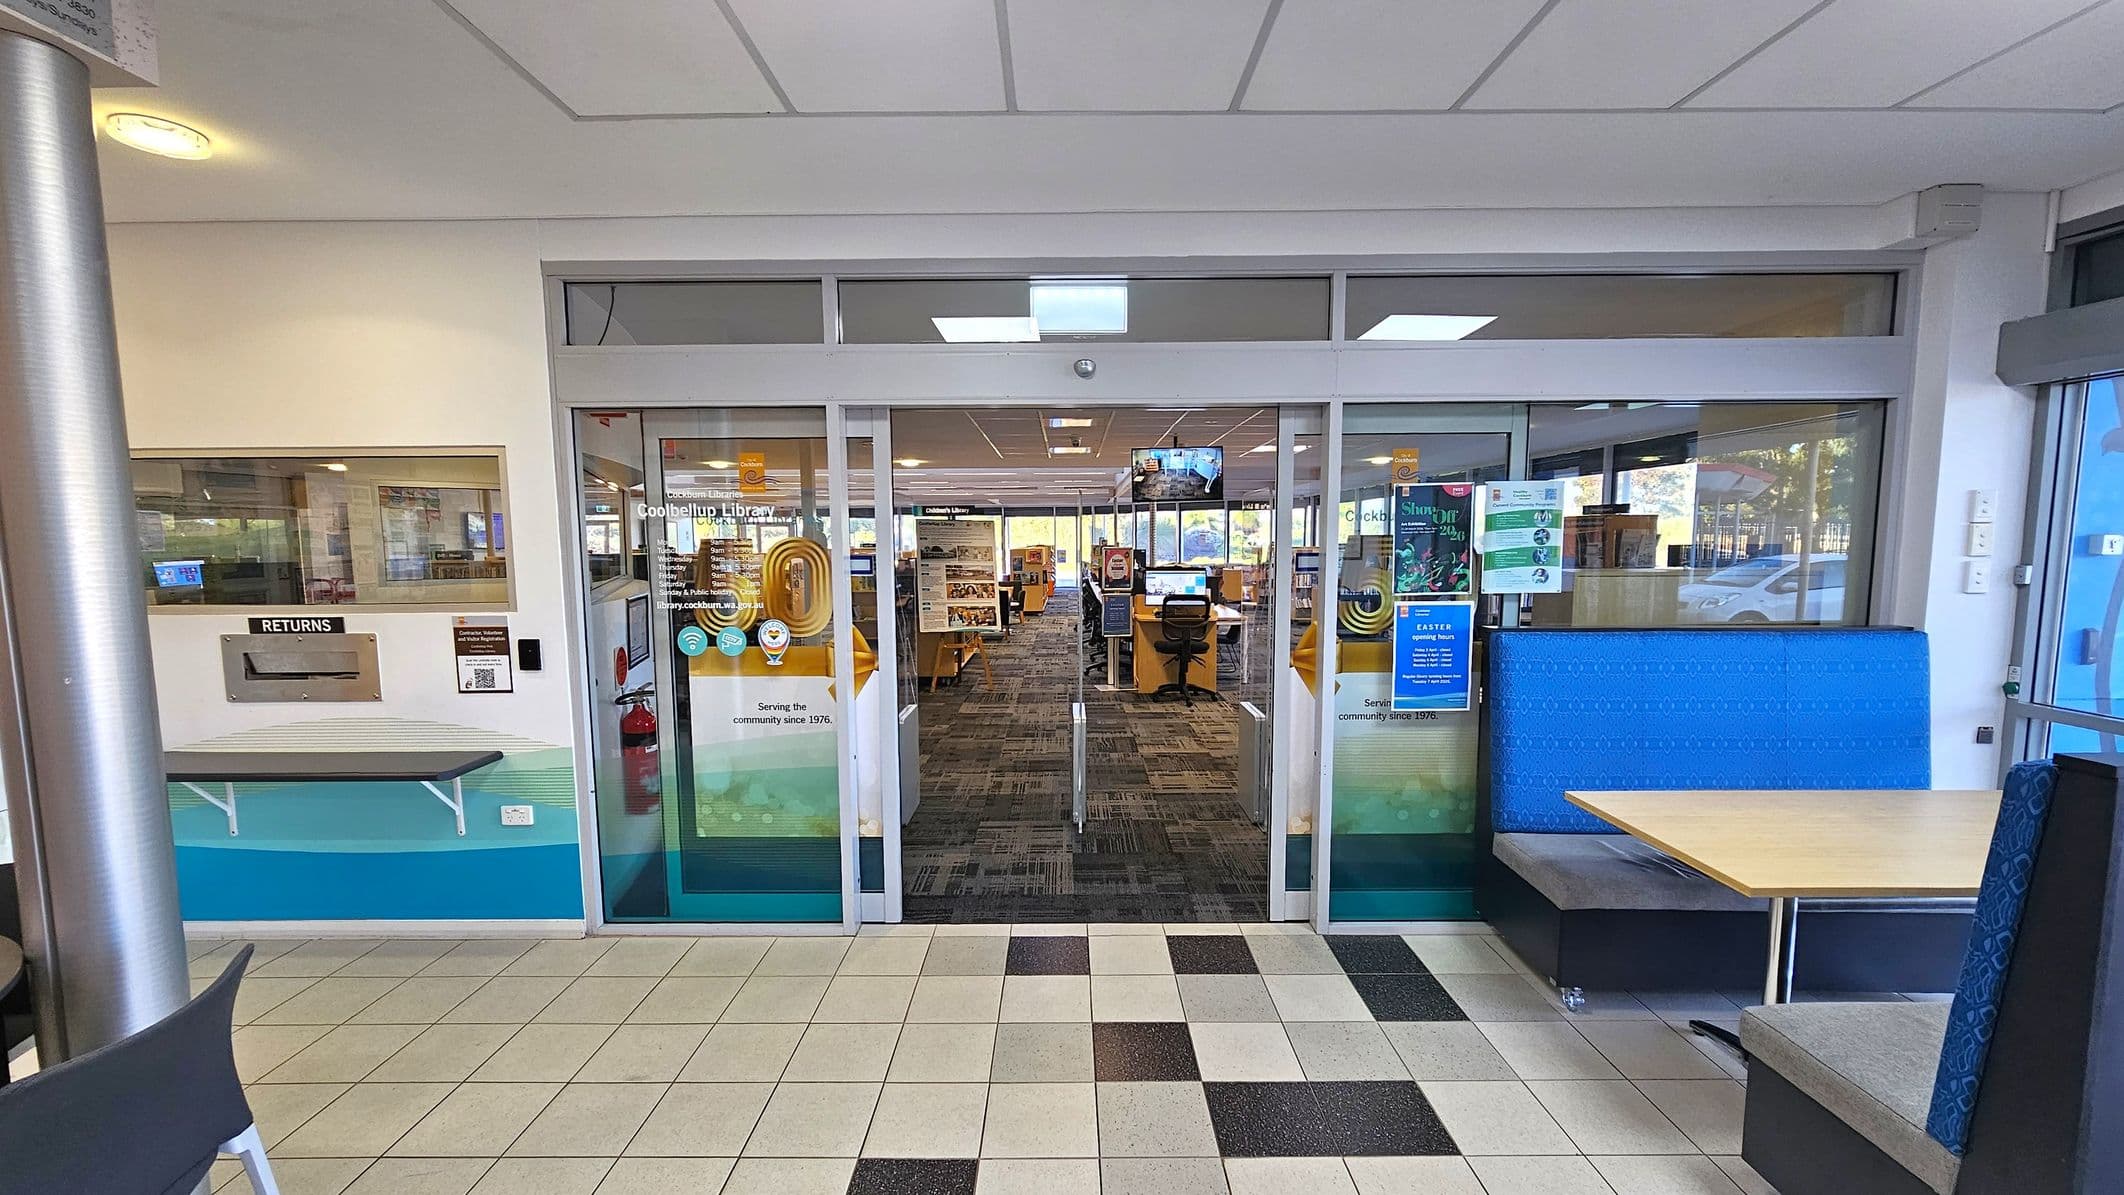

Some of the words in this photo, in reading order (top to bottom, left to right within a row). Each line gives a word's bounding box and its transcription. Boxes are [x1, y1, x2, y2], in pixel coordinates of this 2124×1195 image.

[667, 490, 707, 499] Cockburn
[708, 490, 744, 499] Libraries
[637, 503, 716, 520] Coolbellup
[721, 503, 776, 520] Library
[1345, 510, 1394, 522] Cockbu
[1401, 502, 1436, 516] Show
[1432, 509, 1459, 525] Off
[656, 600, 764, 611] library.cockburn.wa.gov.au
[261, 619, 332, 632] RETURNS
[1416, 623, 1452, 631] EASTER
[758, 702, 791, 713] Serving
[792, 702, 807, 711] the
[1364, 698, 1392, 708] Servin
[733, 715, 782, 726] community
[783, 715, 806, 724] since
[808, 715, 833, 724] 1976.
[1338, 711, 1386, 722] community
[1389, 711, 1412, 720] since
[1414, 711, 1439, 720] 1976.
